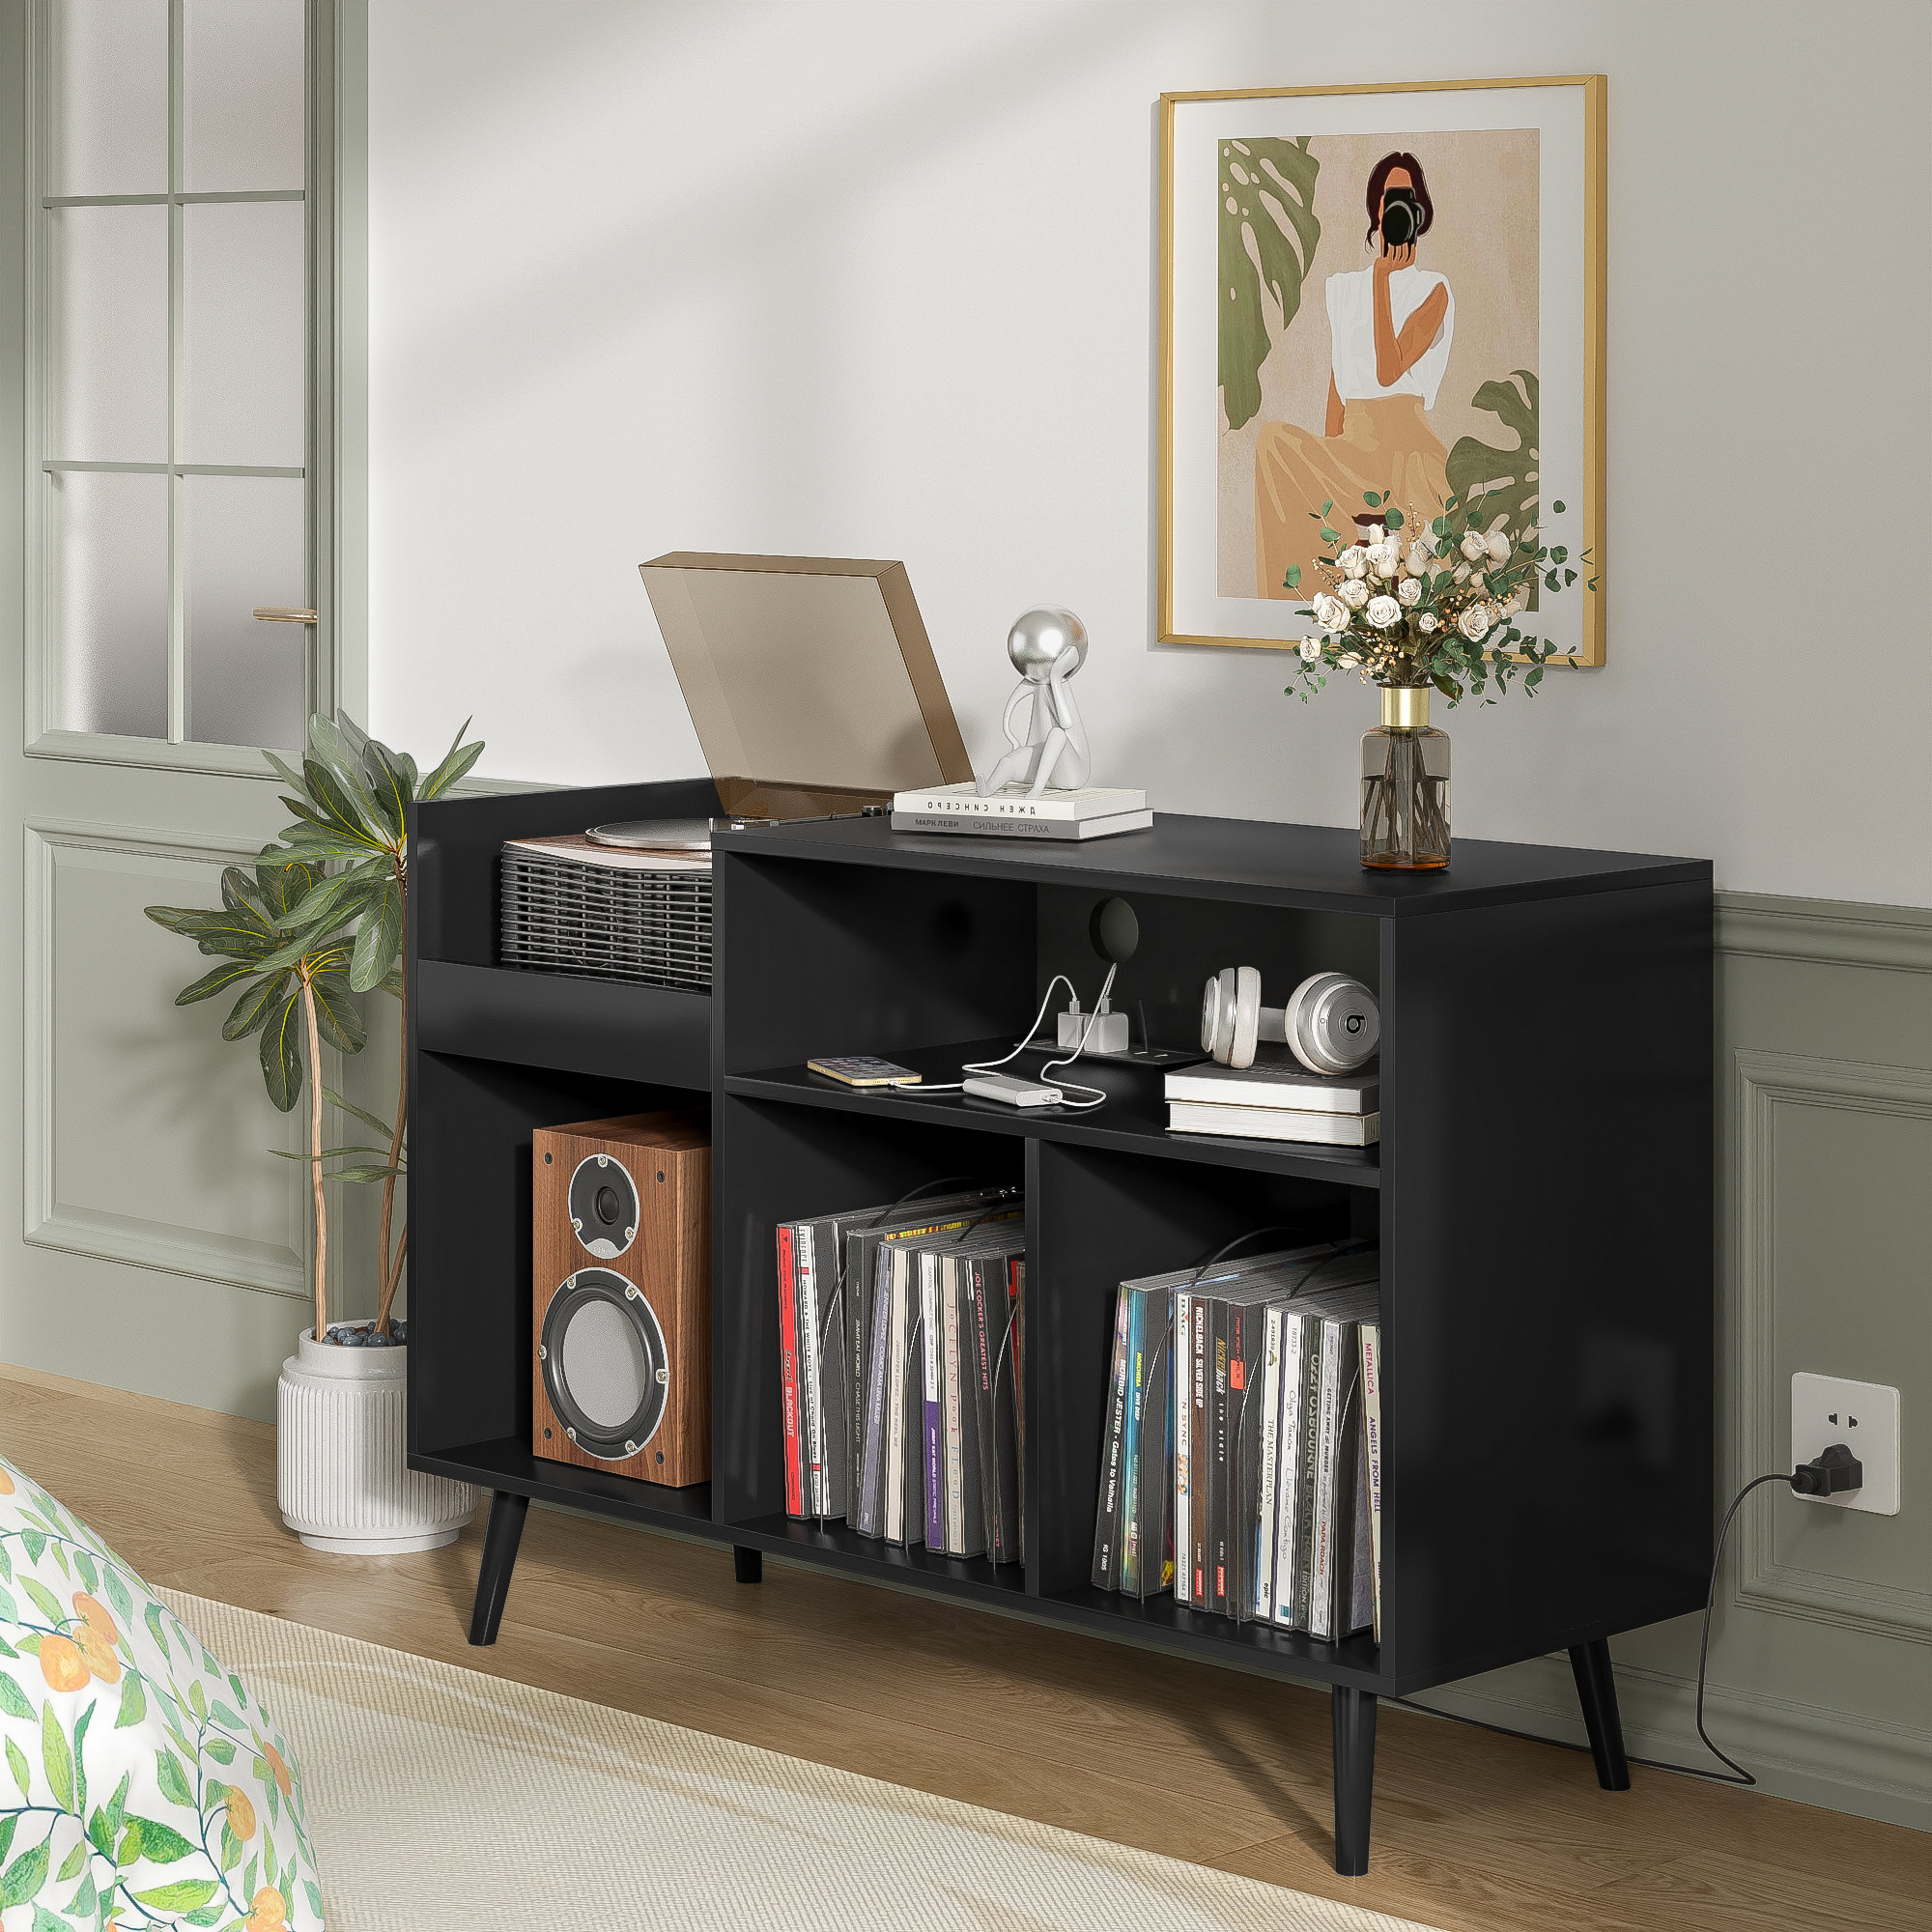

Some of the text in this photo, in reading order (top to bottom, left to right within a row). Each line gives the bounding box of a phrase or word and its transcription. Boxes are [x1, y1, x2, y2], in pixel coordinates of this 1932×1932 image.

[973, 821, 1014, 831] СИЛЬНЕЕ
[1018, 823, 1049, 833] СТРАХА
[979, 1331, 987, 1370] GREATEST
[1365, 1343, 1375, 1395] METALLICA
[1196, 1399, 1204, 1407] UP
[1287, 1390, 1296, 1416] Olga
[1106, 1358, 1126, 1513] MORBID JESTER Gates to Valhalla
[1306, 1395, 1318, 1479] OSBOURNE
[1369, 1416, 1378, 1454] ANGELS
[1280, 1515, 1292, 1560] Contigo
